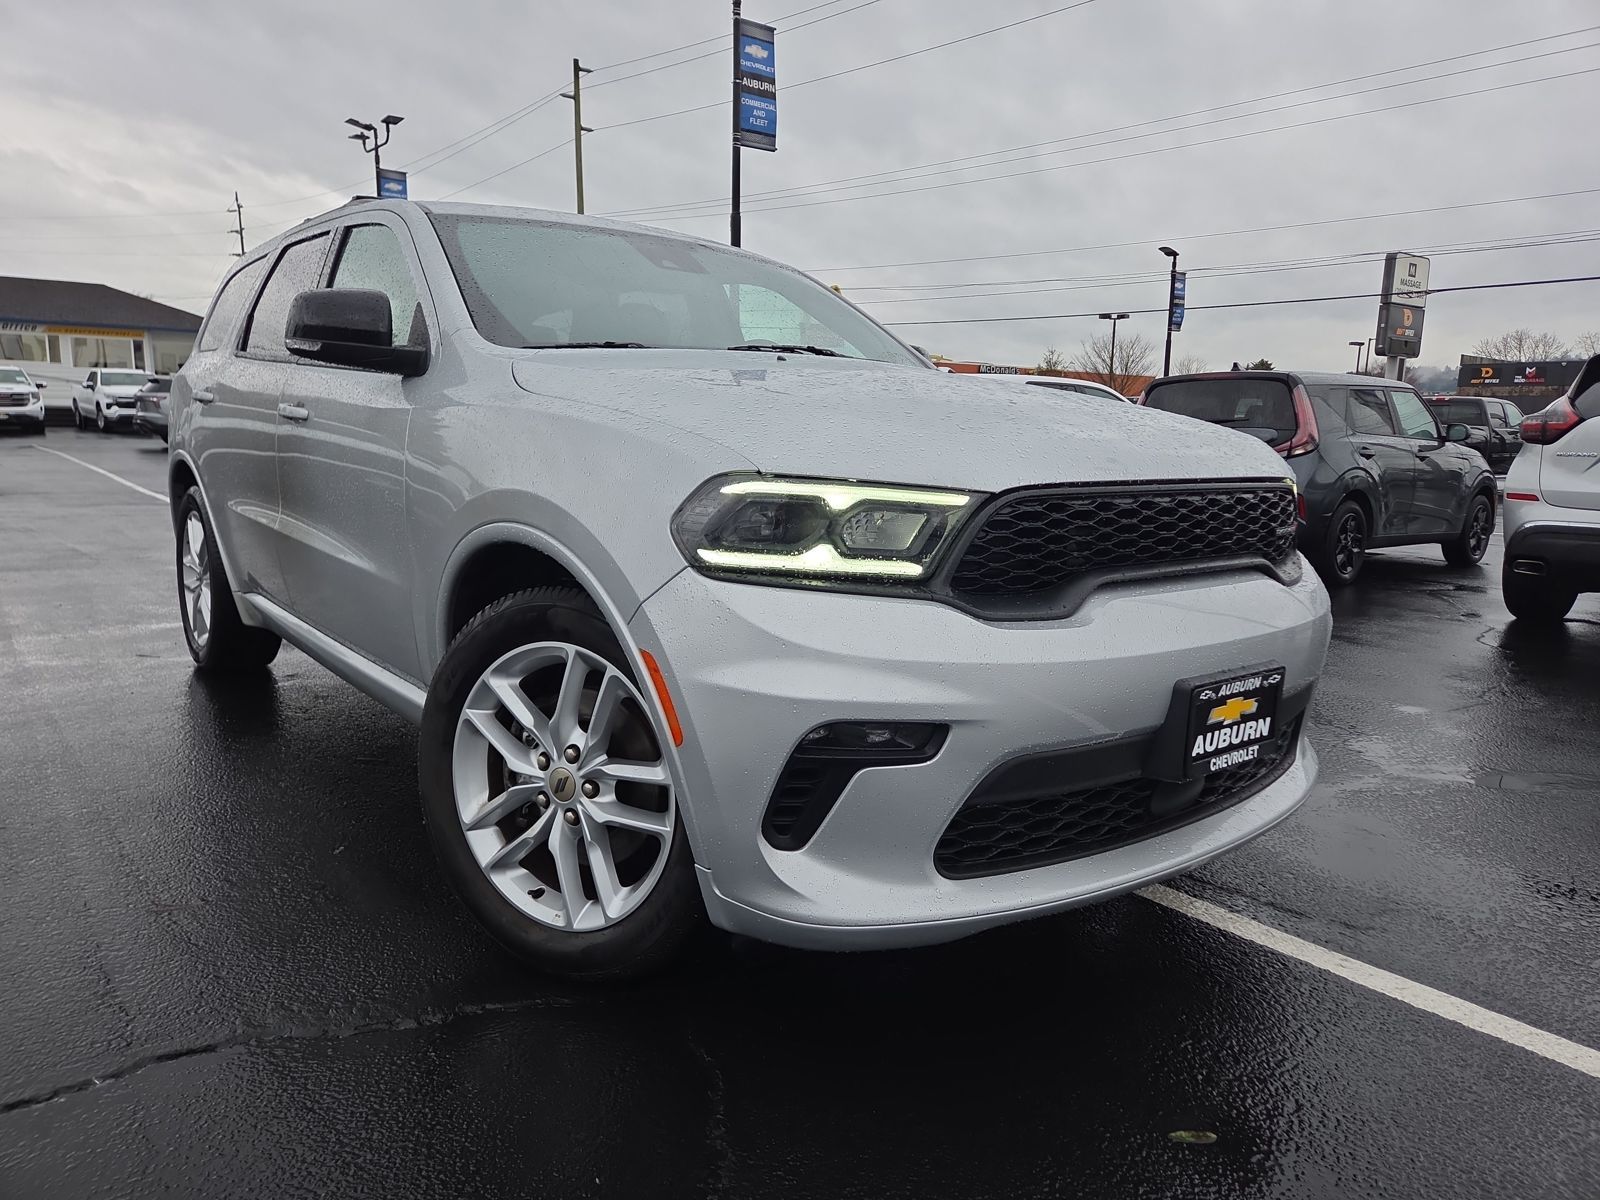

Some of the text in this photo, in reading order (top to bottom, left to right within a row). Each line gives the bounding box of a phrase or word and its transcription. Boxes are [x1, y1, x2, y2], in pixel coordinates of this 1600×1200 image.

[740, 59, 775, 73] CHEVROLET
[742, 77, 776, 93] AUBURN
[741, 97, 776, 111] COMMERCIAL
[749, 117, 768, 127] FLEET
[1400, 278, 1422, 289] MASSAGE
[1218, 677, 1262, 697] AUBURN
[1191, 717, 1271, 757] AUBURN
[1210, 745, 1259, 771] CHEVROLET
